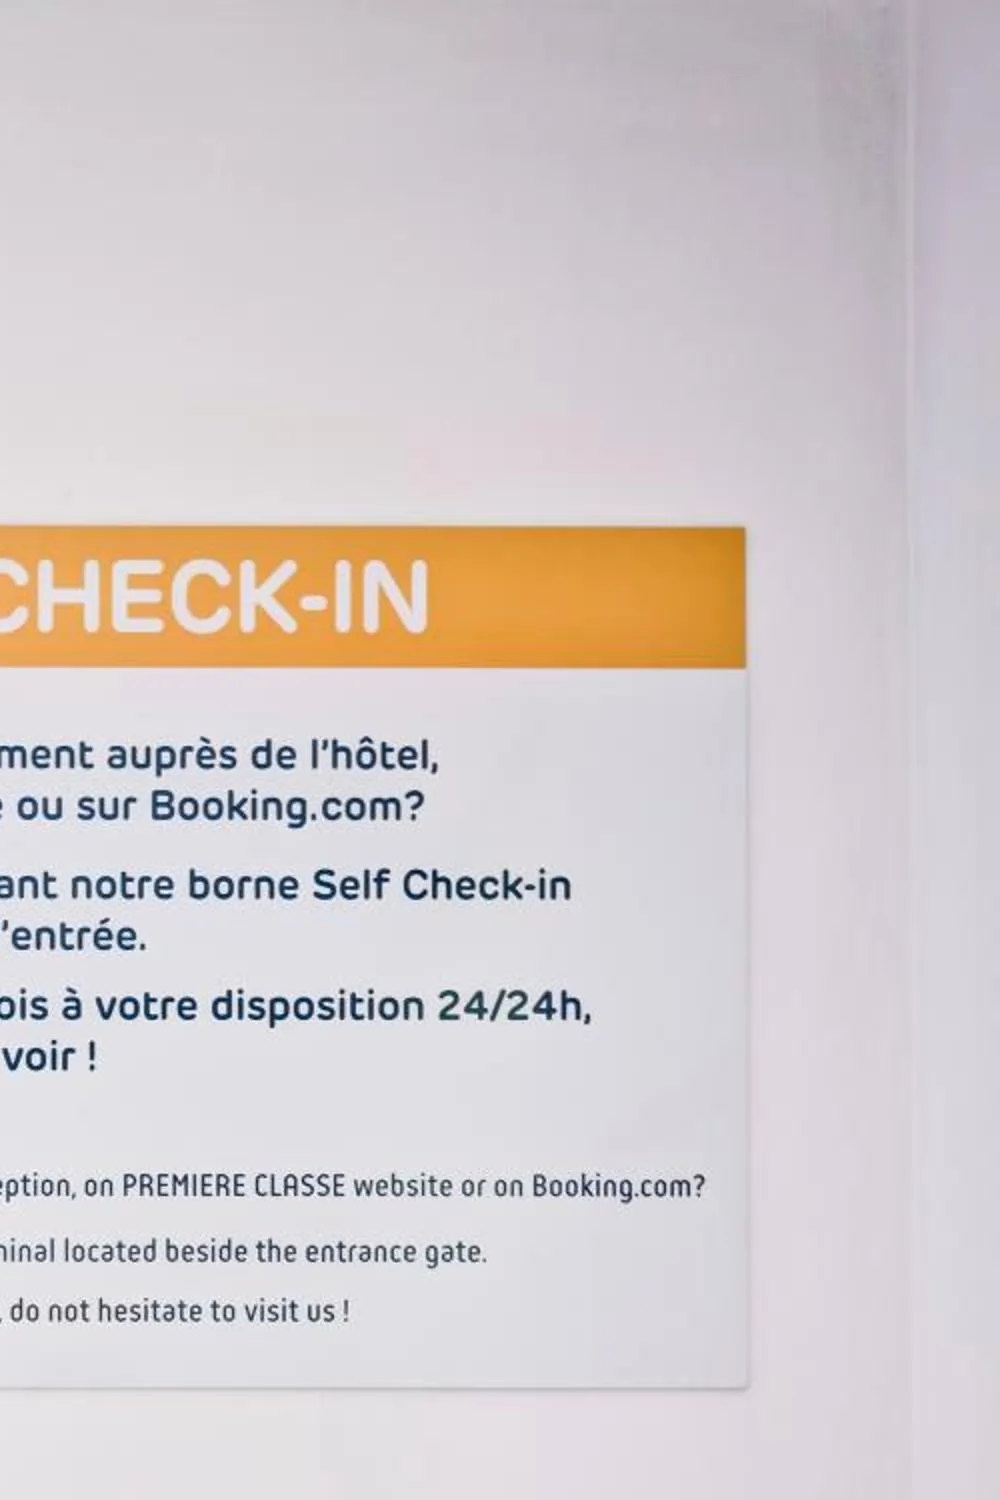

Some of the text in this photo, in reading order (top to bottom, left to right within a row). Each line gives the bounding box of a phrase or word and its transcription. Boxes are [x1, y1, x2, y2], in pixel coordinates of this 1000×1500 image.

[106, 735, 239, 779] auprès
[250, 737, 298, 771] de
[310, 735, 439, 776] l'hôtel,
[16, 794, 64, 822] ou
[76, 795, 139, 822] sur
[150, 787, 426, 830] Booking.com?
[70, 870, 176, 901] notre
[188, 867, 300, 902] borne
[312, 867, 392, 902] Self
[402, 866, 572, 902] Check-in
[60, 985, 83, 1022] à
[94, 991, 199, 1022] votre
[210, 987, 425, 1030] disposition
[437, 987, 592, 1026] 24/24h,
[0, 1038, 77, 1073] voir
[87, 1039, 97, 1073] !
[83, 1177, 115, 1198] on
[122, 1172, 247, 1198] PREMIERE
[254, 1172, 347, 1198] CLASSE
[353, 1171, 454, 1198] website
[460, 1178, 488, 1198] or
[493, 1178, 524, 1198] on
[532, 1171, 707, 1206] Booking.com?
[63, 1236, 158, 1264] located
[165, 1236, 249, 1264] beside
[254, 1237, 298, 1264] the
[304, 1240, 418, 1264] entrance
[424, 1240, 488, 1270] gate.
[9, 1296, 41, 1325] do
[47, 1299, 91, 1324] not
[97, 1296, 203, 1324] hesitate
[209, 1299, 237, 1324] to
[243, 1296, 300, 1324] visit
[306, 1303, 336, 1324] us
[342, 1298, 350, 1323] !
